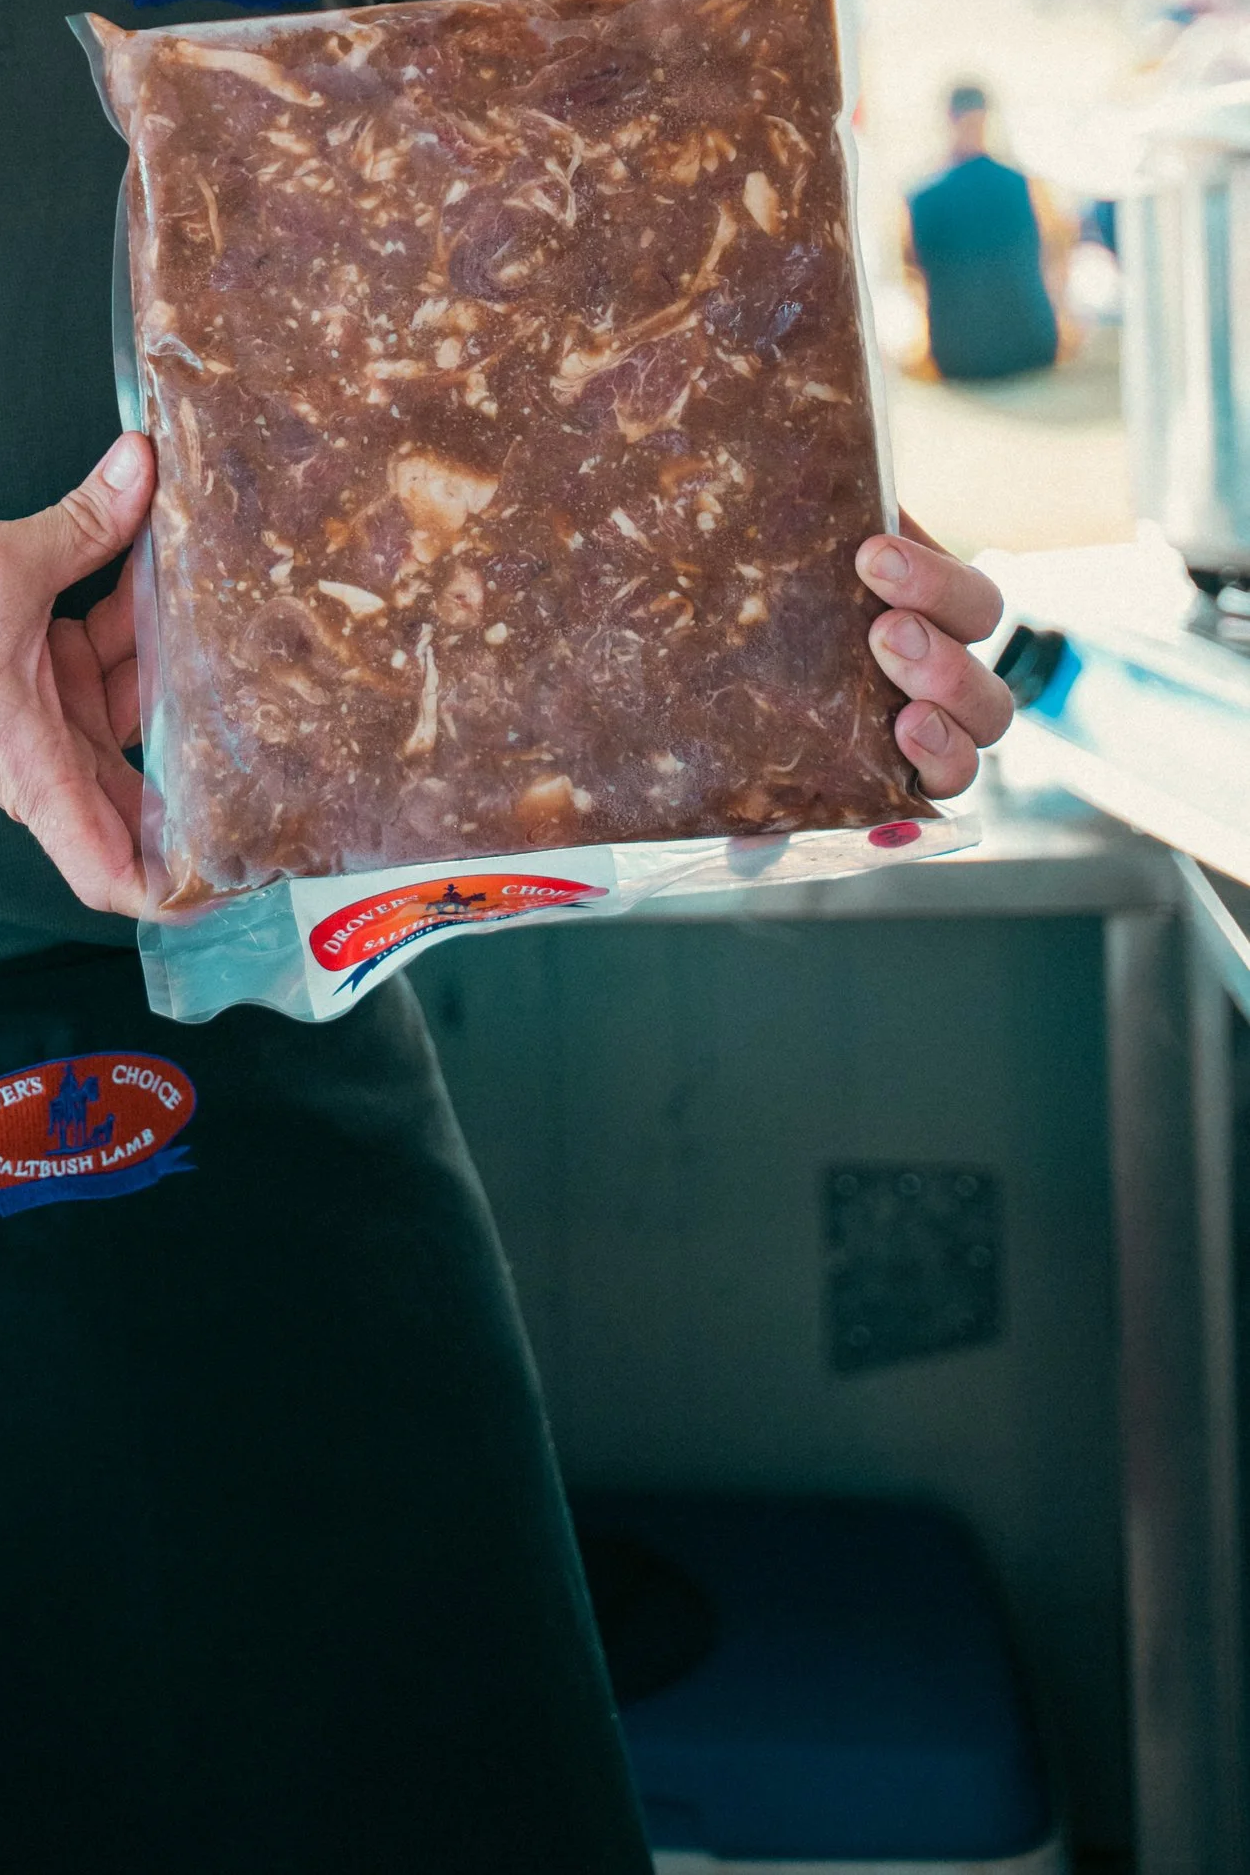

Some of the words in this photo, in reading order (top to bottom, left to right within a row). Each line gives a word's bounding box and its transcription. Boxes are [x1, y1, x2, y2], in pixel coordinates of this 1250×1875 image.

[375, 926, 433, 961] FLAVOUR
[111, 1064, 183, 1111] CHOICE
[100, 1128, 156, 1167] LAMB
